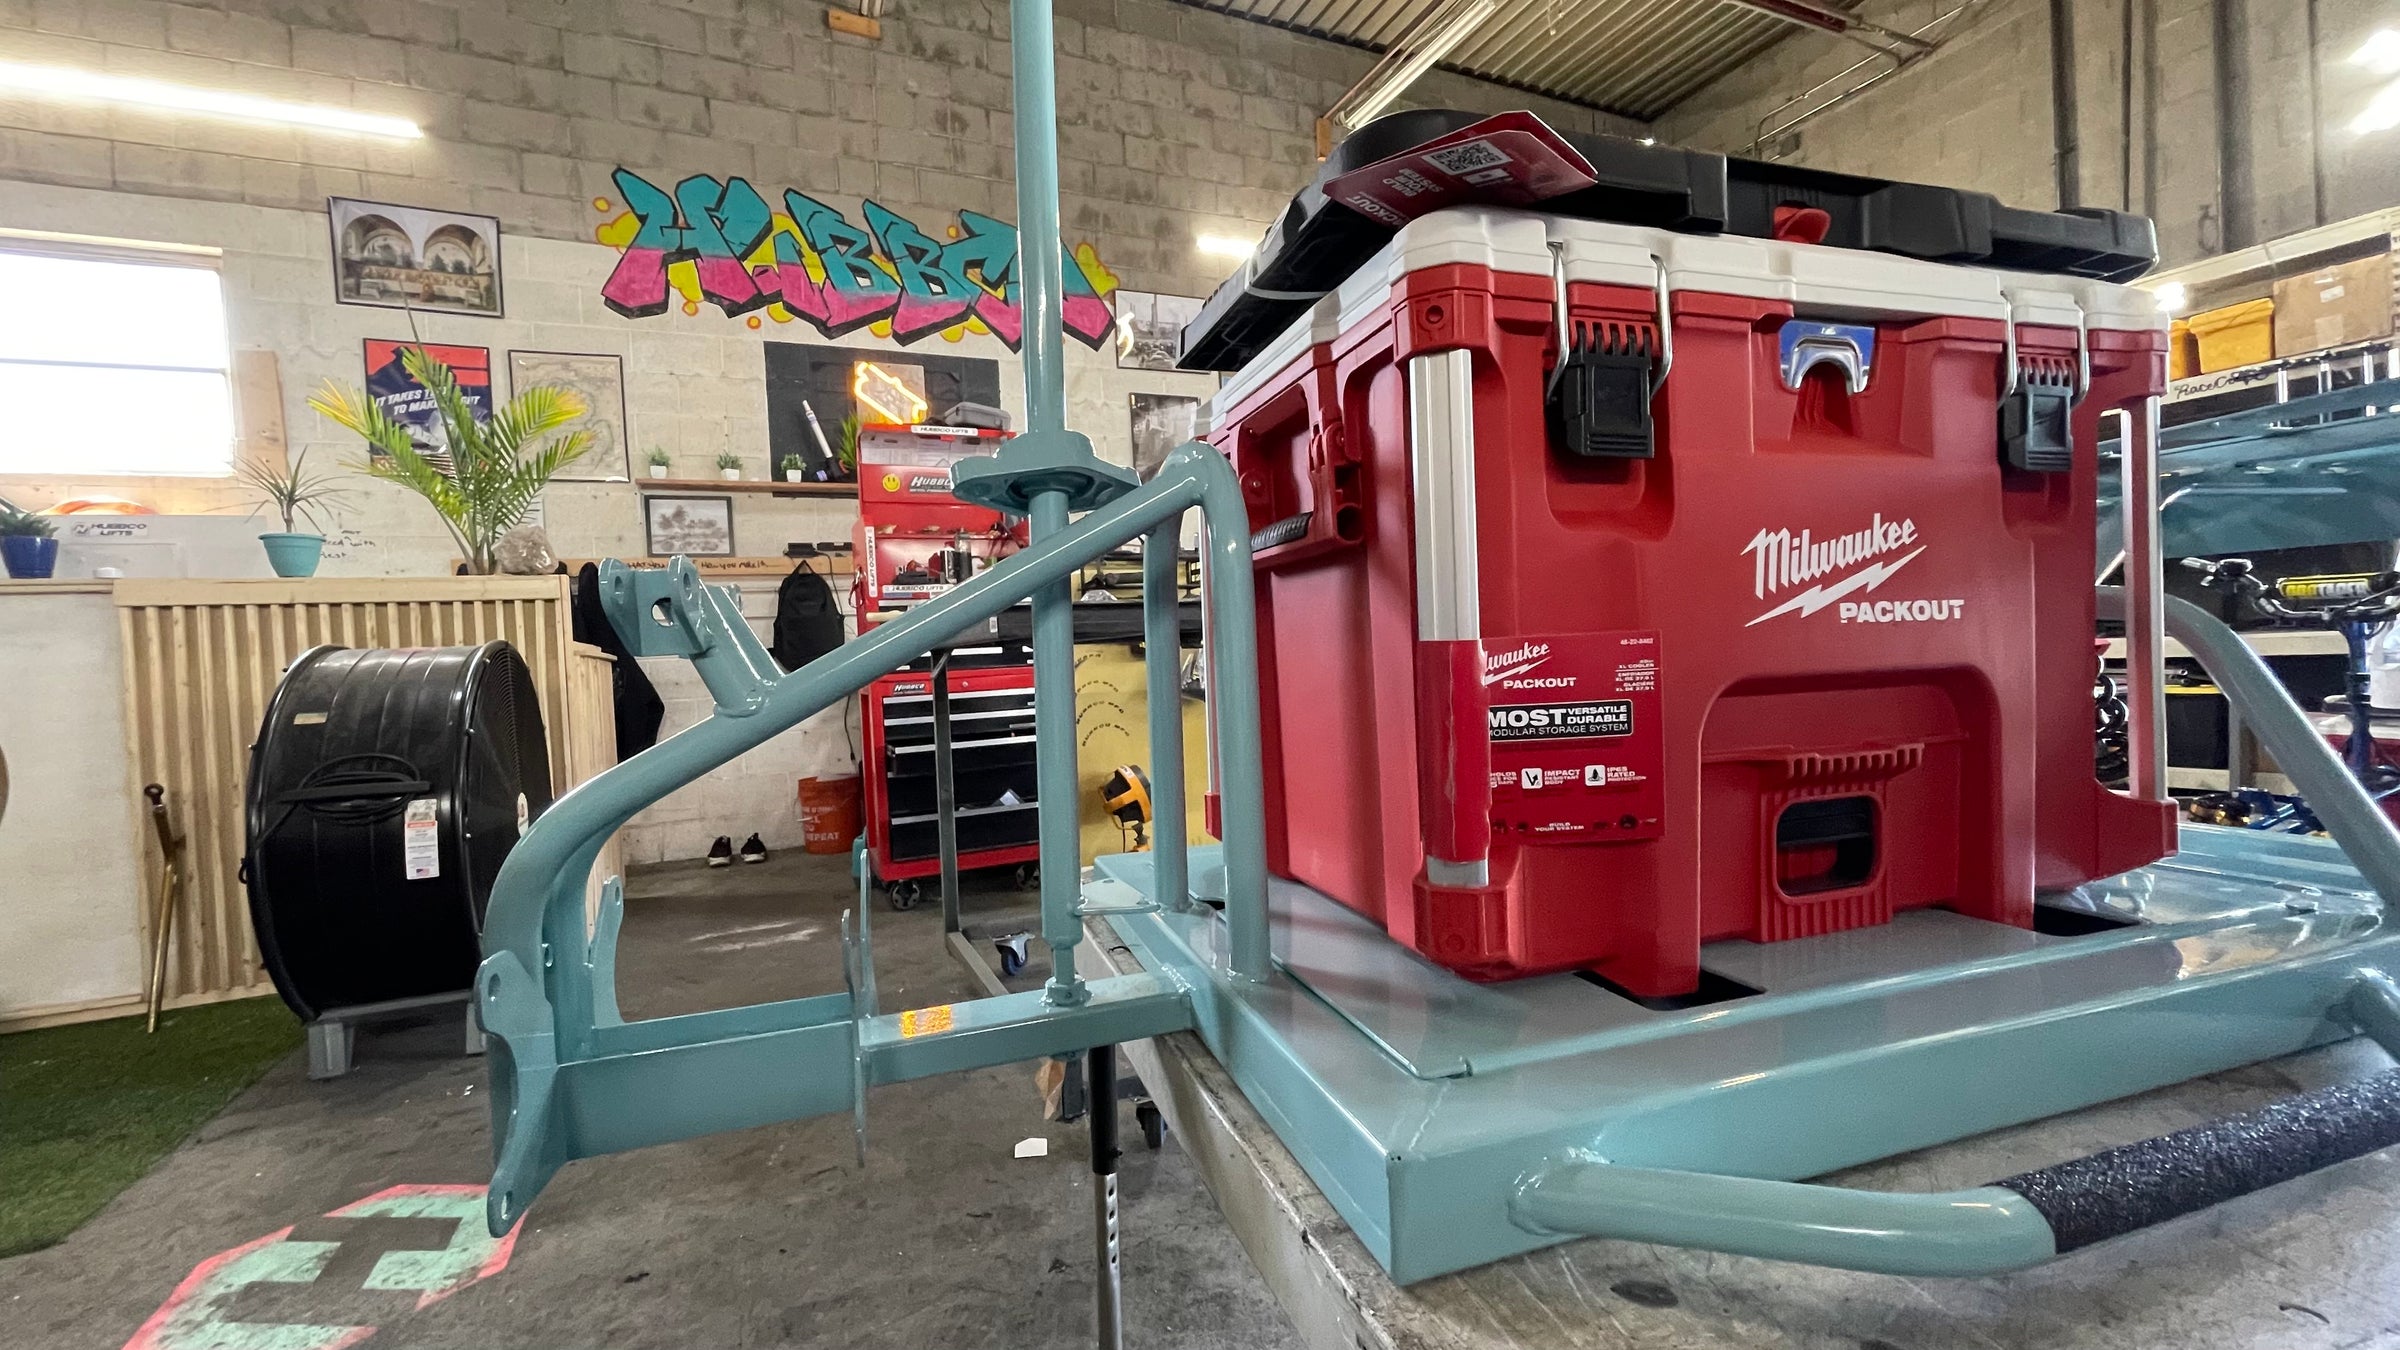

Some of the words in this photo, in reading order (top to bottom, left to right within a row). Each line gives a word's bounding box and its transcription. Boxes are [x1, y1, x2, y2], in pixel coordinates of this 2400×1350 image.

[387, 389, 423, 405] TAKES
[393, 404, 407, 415] TO
[1740, 512, 1919, 601] Milwaukee
[1839, 599, 1965, 624] PACKOUT
[1503, 677, 1577, 689] PACKOUT
[1567, 704, 1627, 715] VERSATILE
[1489, 709, 1566, 728] MOST
[1567, 714, 1628, 724] DURABLE
[1539, 724, 1587, 735] STORAGE
[1589, 722, 1629, 733] SYSTEM
[1544, 769, 1581, 777] IMPACT
